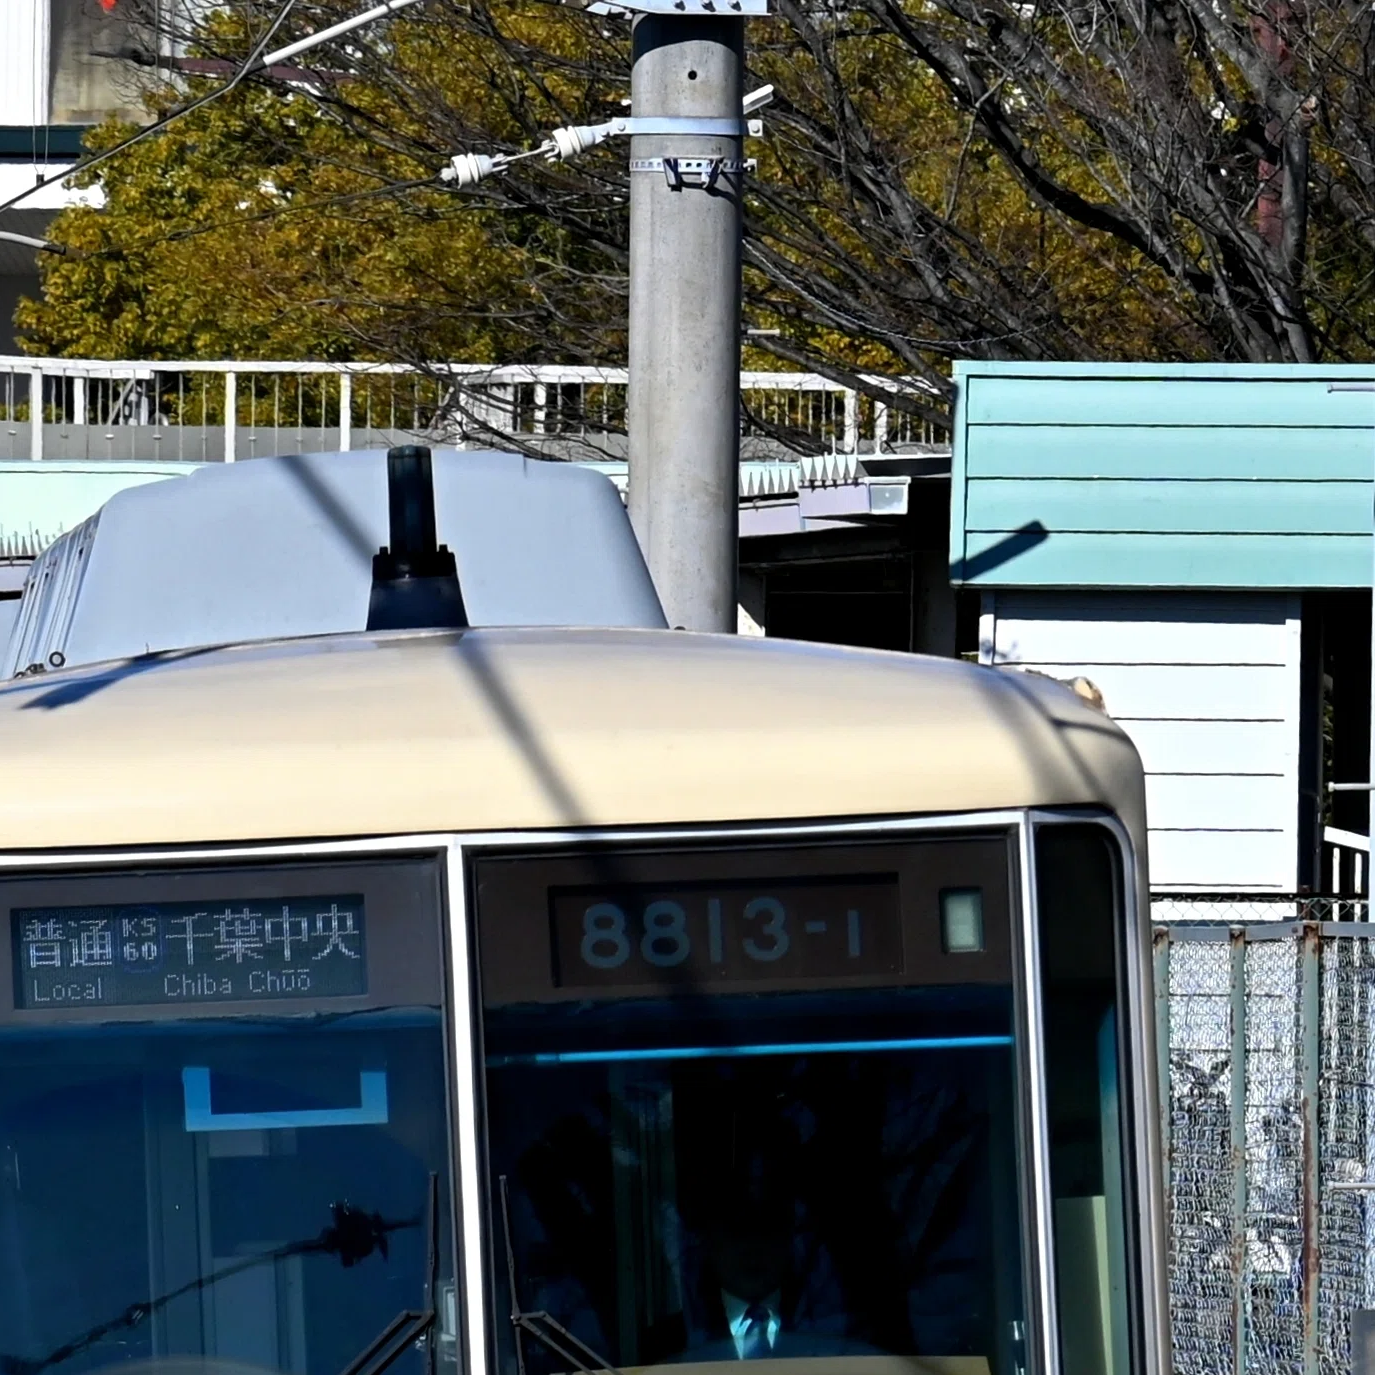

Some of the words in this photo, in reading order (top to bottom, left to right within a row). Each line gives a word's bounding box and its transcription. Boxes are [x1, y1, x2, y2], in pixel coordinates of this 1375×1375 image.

[23, 918, 113, 968] 普通
[165, 904, 361, 965] 千葉中央
[121, 917, 157, 938] KS
[580, 897, 862, 969] 8813-1
[123, 941, 158, 961] 60
[33, 976, 102, 1002] Local
[164, 973, 232, 997] Chiba
